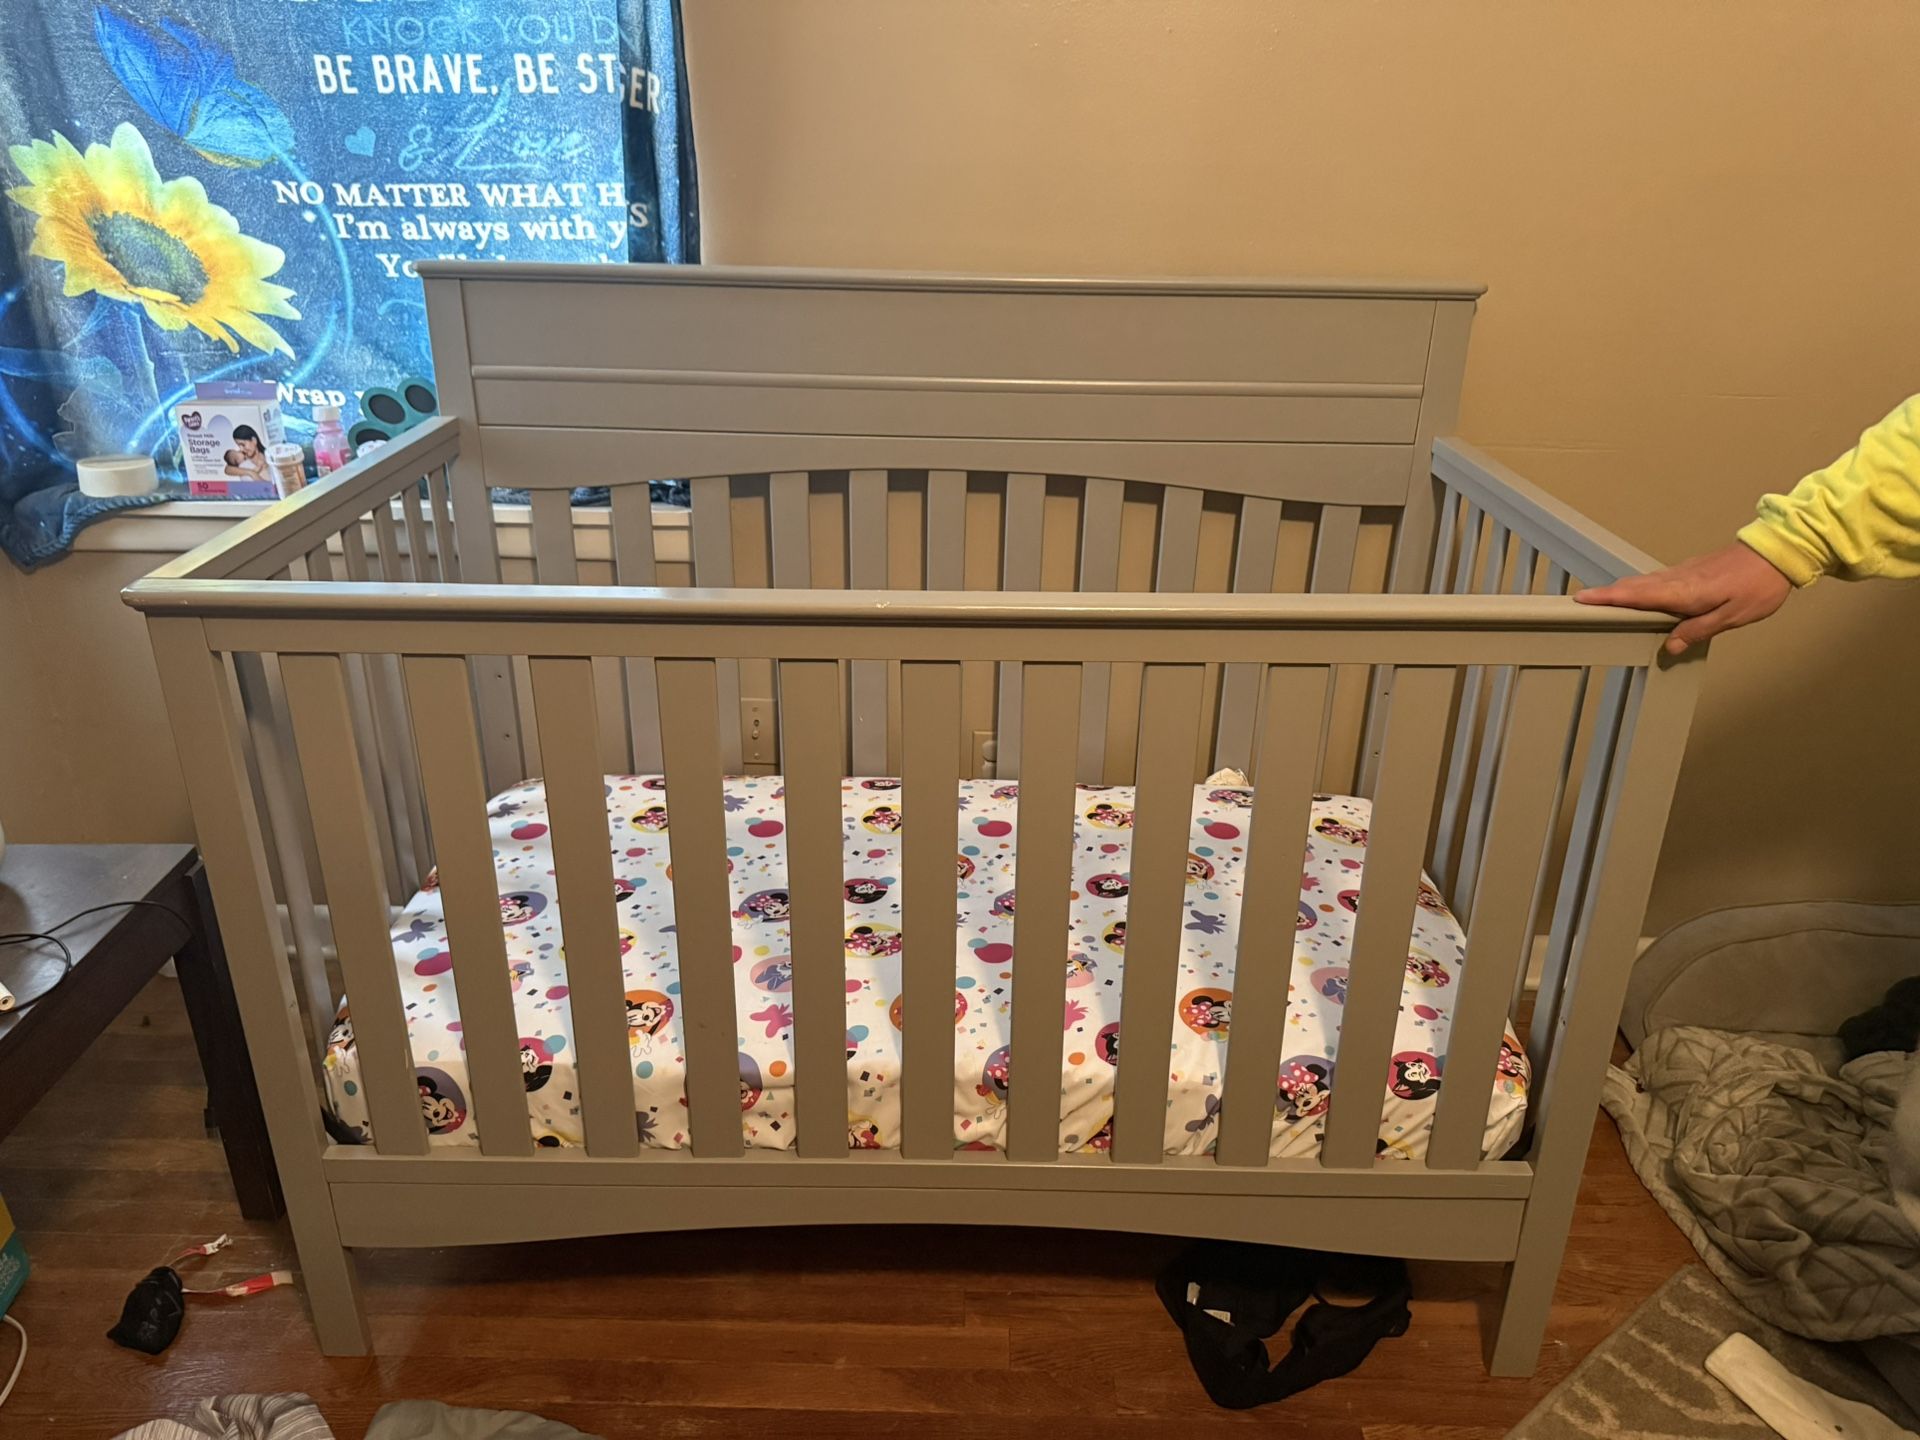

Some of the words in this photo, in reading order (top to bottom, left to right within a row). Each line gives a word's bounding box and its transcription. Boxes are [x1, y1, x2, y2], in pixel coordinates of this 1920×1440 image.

[341, 16, 480, 47] KNOCK
[494, 15, 576, 44] YOU
[316, 54, 358, 94] BE
[515, 52, 560, 94] BE
[274, 180, 324, 205] NO
[334, 183, 470, 207] MATTER
[478, 183, 586, 208] WHAT
[334, 213, 391, 240] I'm
[401, 214, 510, 250] always
[520, 213, 596, 241] with
[188, 439, 221, 448] Storage
[190, 446, 211, 455] Bags
